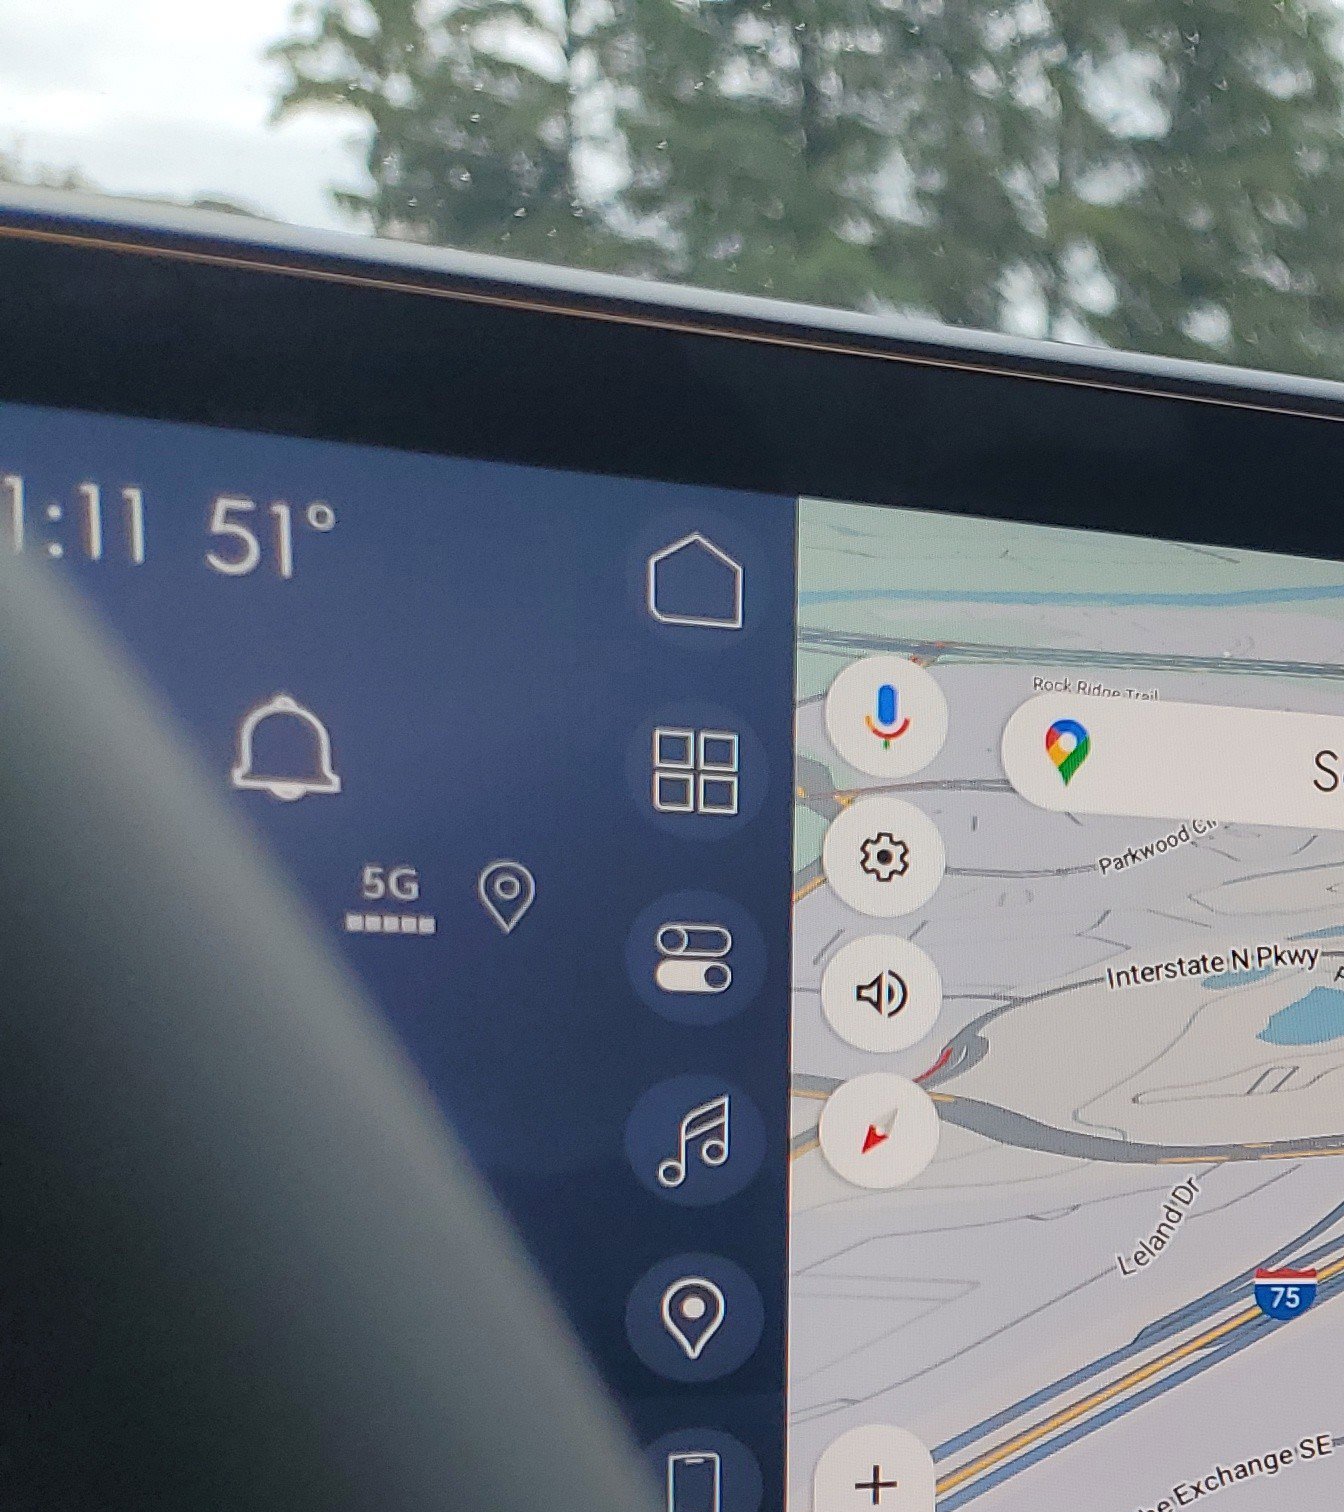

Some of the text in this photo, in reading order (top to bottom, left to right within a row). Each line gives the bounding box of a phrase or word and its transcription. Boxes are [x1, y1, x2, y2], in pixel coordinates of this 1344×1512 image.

[206, 497, 337, 580] 51°
[1033, 677, 1071, 692] Rock
[1098, 825, 1190, 874] Parkwood
[363, 866, 420, 900] 5G
[1106, 945, 1320, 988] Interstate N Pkwy
[1116, 1175, 1202, 1278] Leland Dr
[1270, 1286, 1301, 1309] 75
[1170, 1441, 1296, 1507] Exchange
[1300, 1431, 1334, 1461] SE
